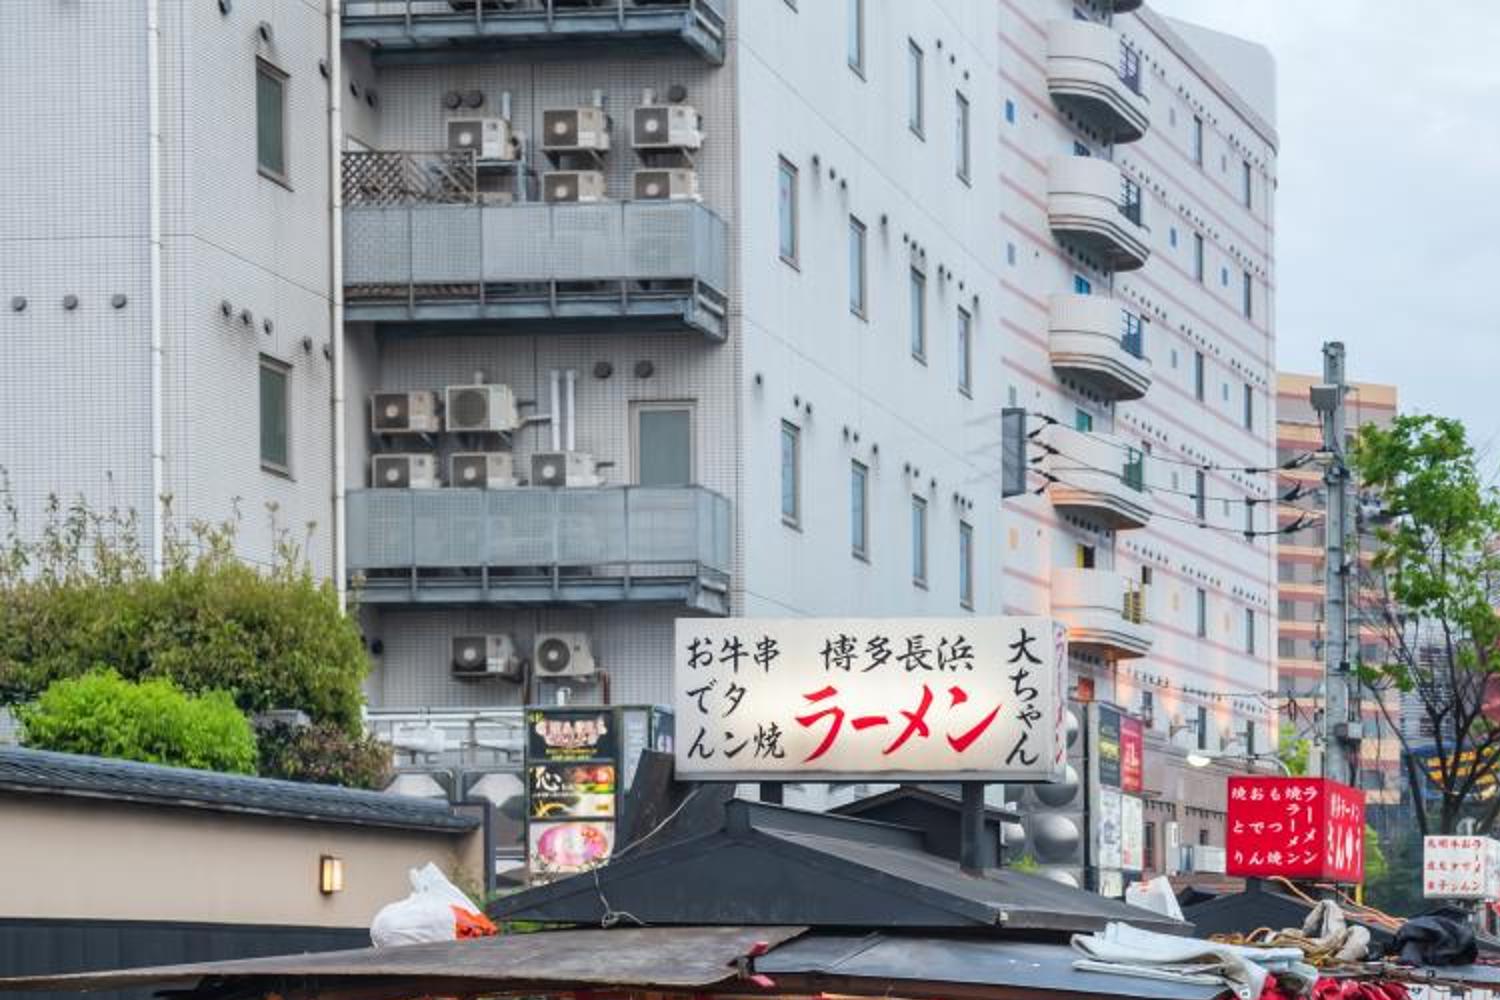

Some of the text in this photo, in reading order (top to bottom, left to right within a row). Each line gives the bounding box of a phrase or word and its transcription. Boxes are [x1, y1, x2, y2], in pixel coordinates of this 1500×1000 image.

[686, 636, 715, 760] おでん
[719, 636, 750, 757] 牛タン
[753, 635, 787, 759] 串焼
[819, 634, 976, 673] 博多長浜
[1005, 627, 1044, 767] 大ちゃん
[795, 684, 1003, 763] ラーメン
[1248, 787, 1265, 865] おでん
[1302, 786, 1319, 865] ラーメン
